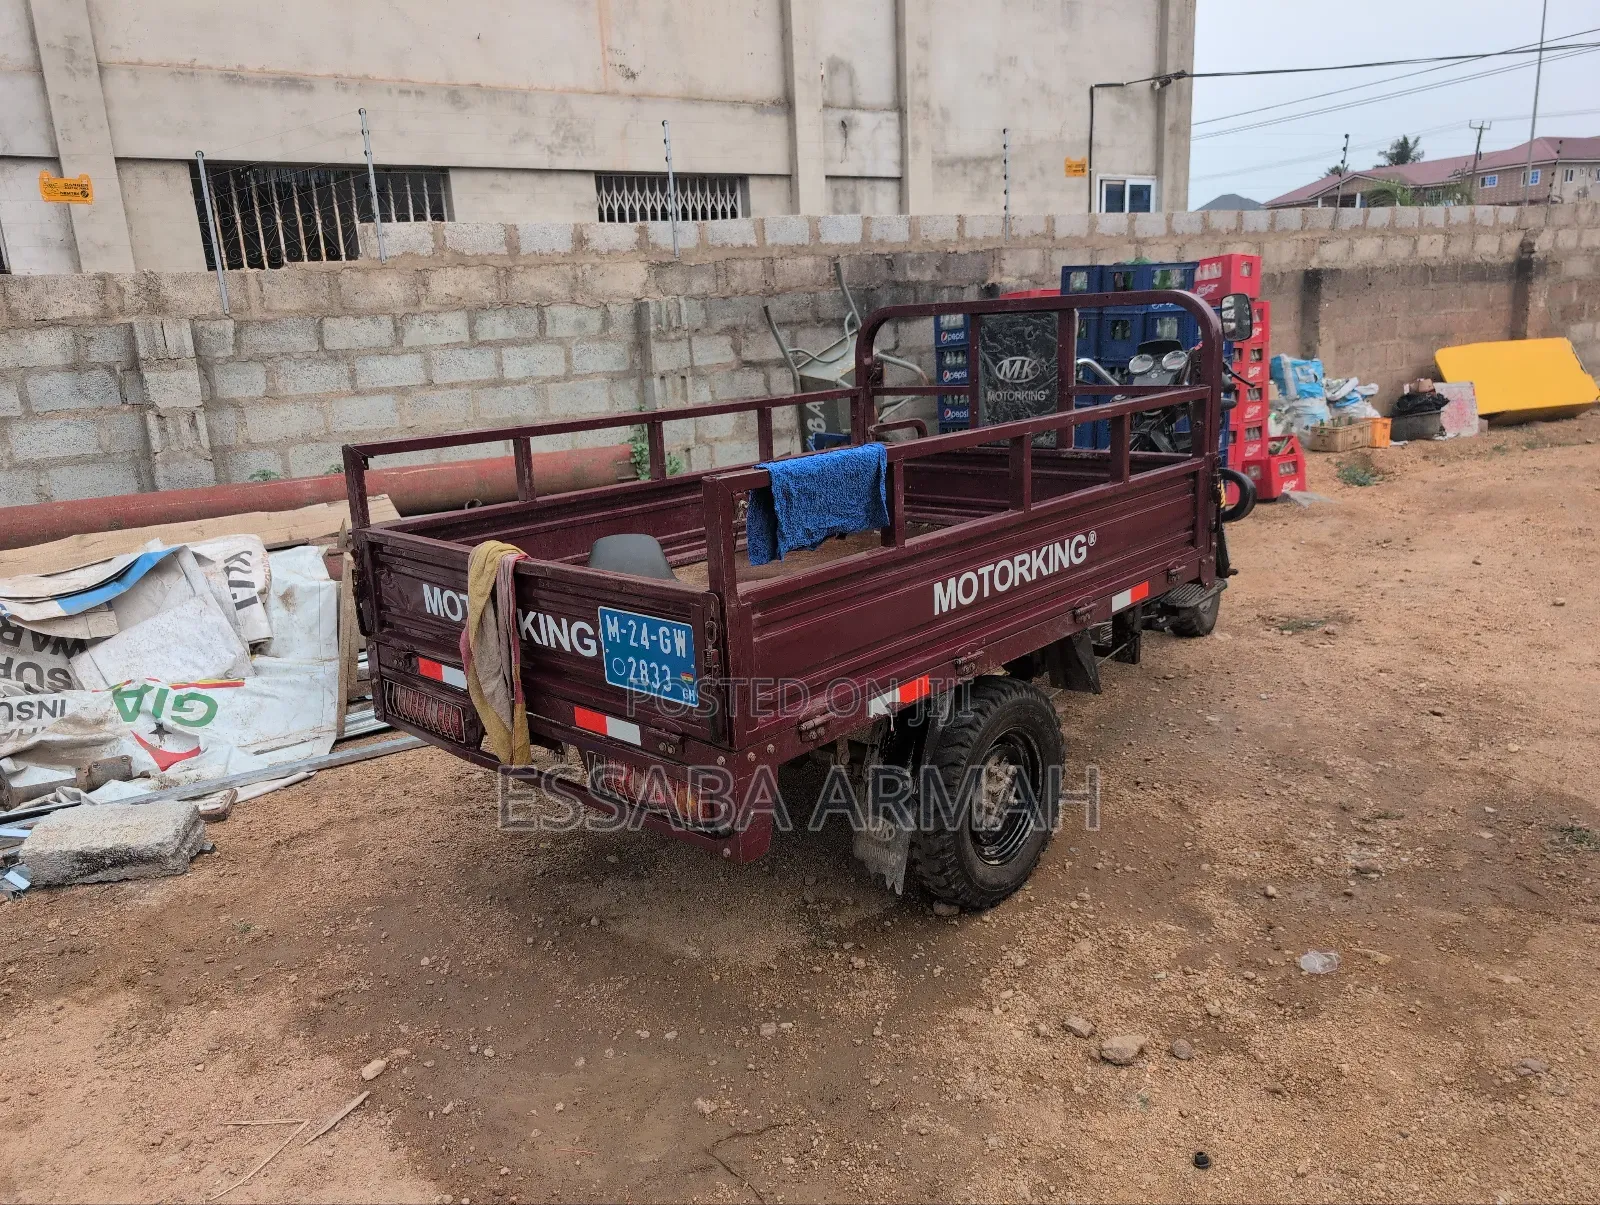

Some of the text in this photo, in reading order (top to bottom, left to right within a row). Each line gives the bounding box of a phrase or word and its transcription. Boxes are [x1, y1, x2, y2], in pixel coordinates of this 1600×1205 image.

[947, 331, 964, 341] pepsi
[949, 369, 967, 380] pepsi
[1000, 359, 1036, 379] MK
[951, 409, 969, 419] pepsi
[422, 584, 598, 657] MOKING
[605, 614, 686, 659] M-24-GW
[627, 657, 672, 692] 2833
[682, 688, 696, 702] GH
[112, 684, 218, 728] GIA
